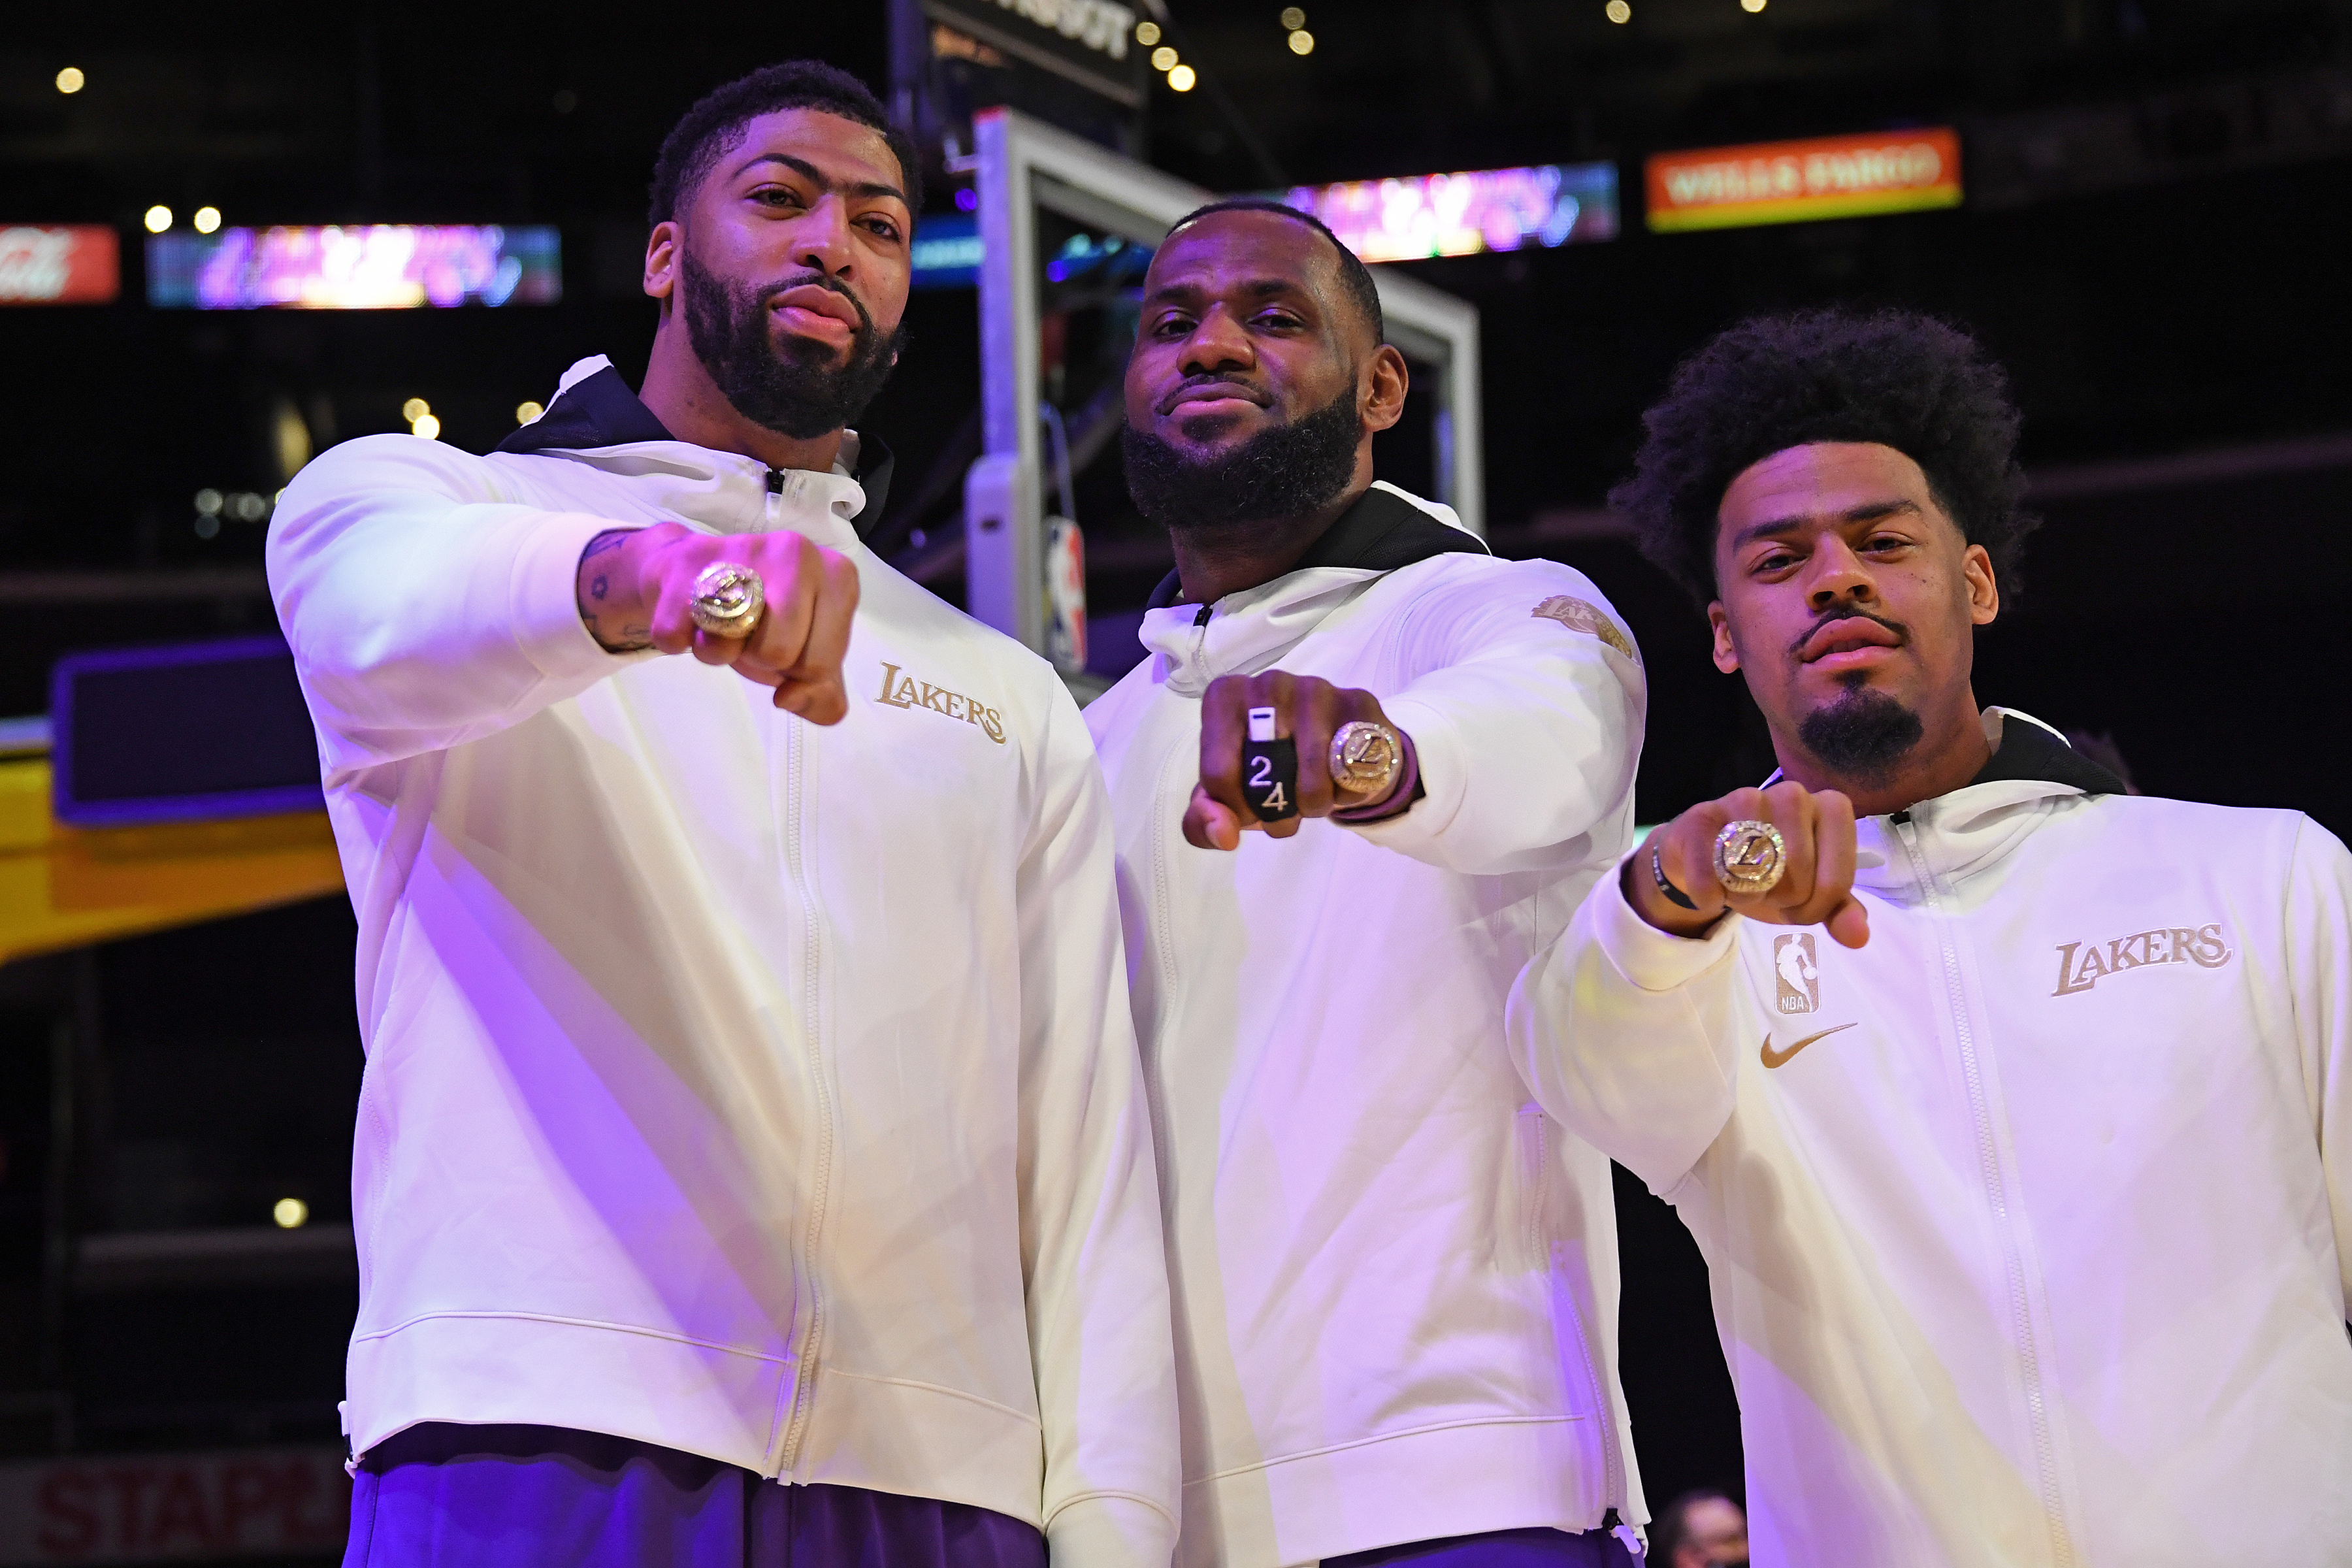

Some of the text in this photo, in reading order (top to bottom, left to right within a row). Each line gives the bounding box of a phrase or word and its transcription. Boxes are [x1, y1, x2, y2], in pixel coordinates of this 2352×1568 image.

[875, 661, 1007, 745] LAKERS
[2051, 923, 2232, 998] LAKERS
[1782, 996, 1805, 1011] NBA
[38, 1461, 351, 1558] STAPL
